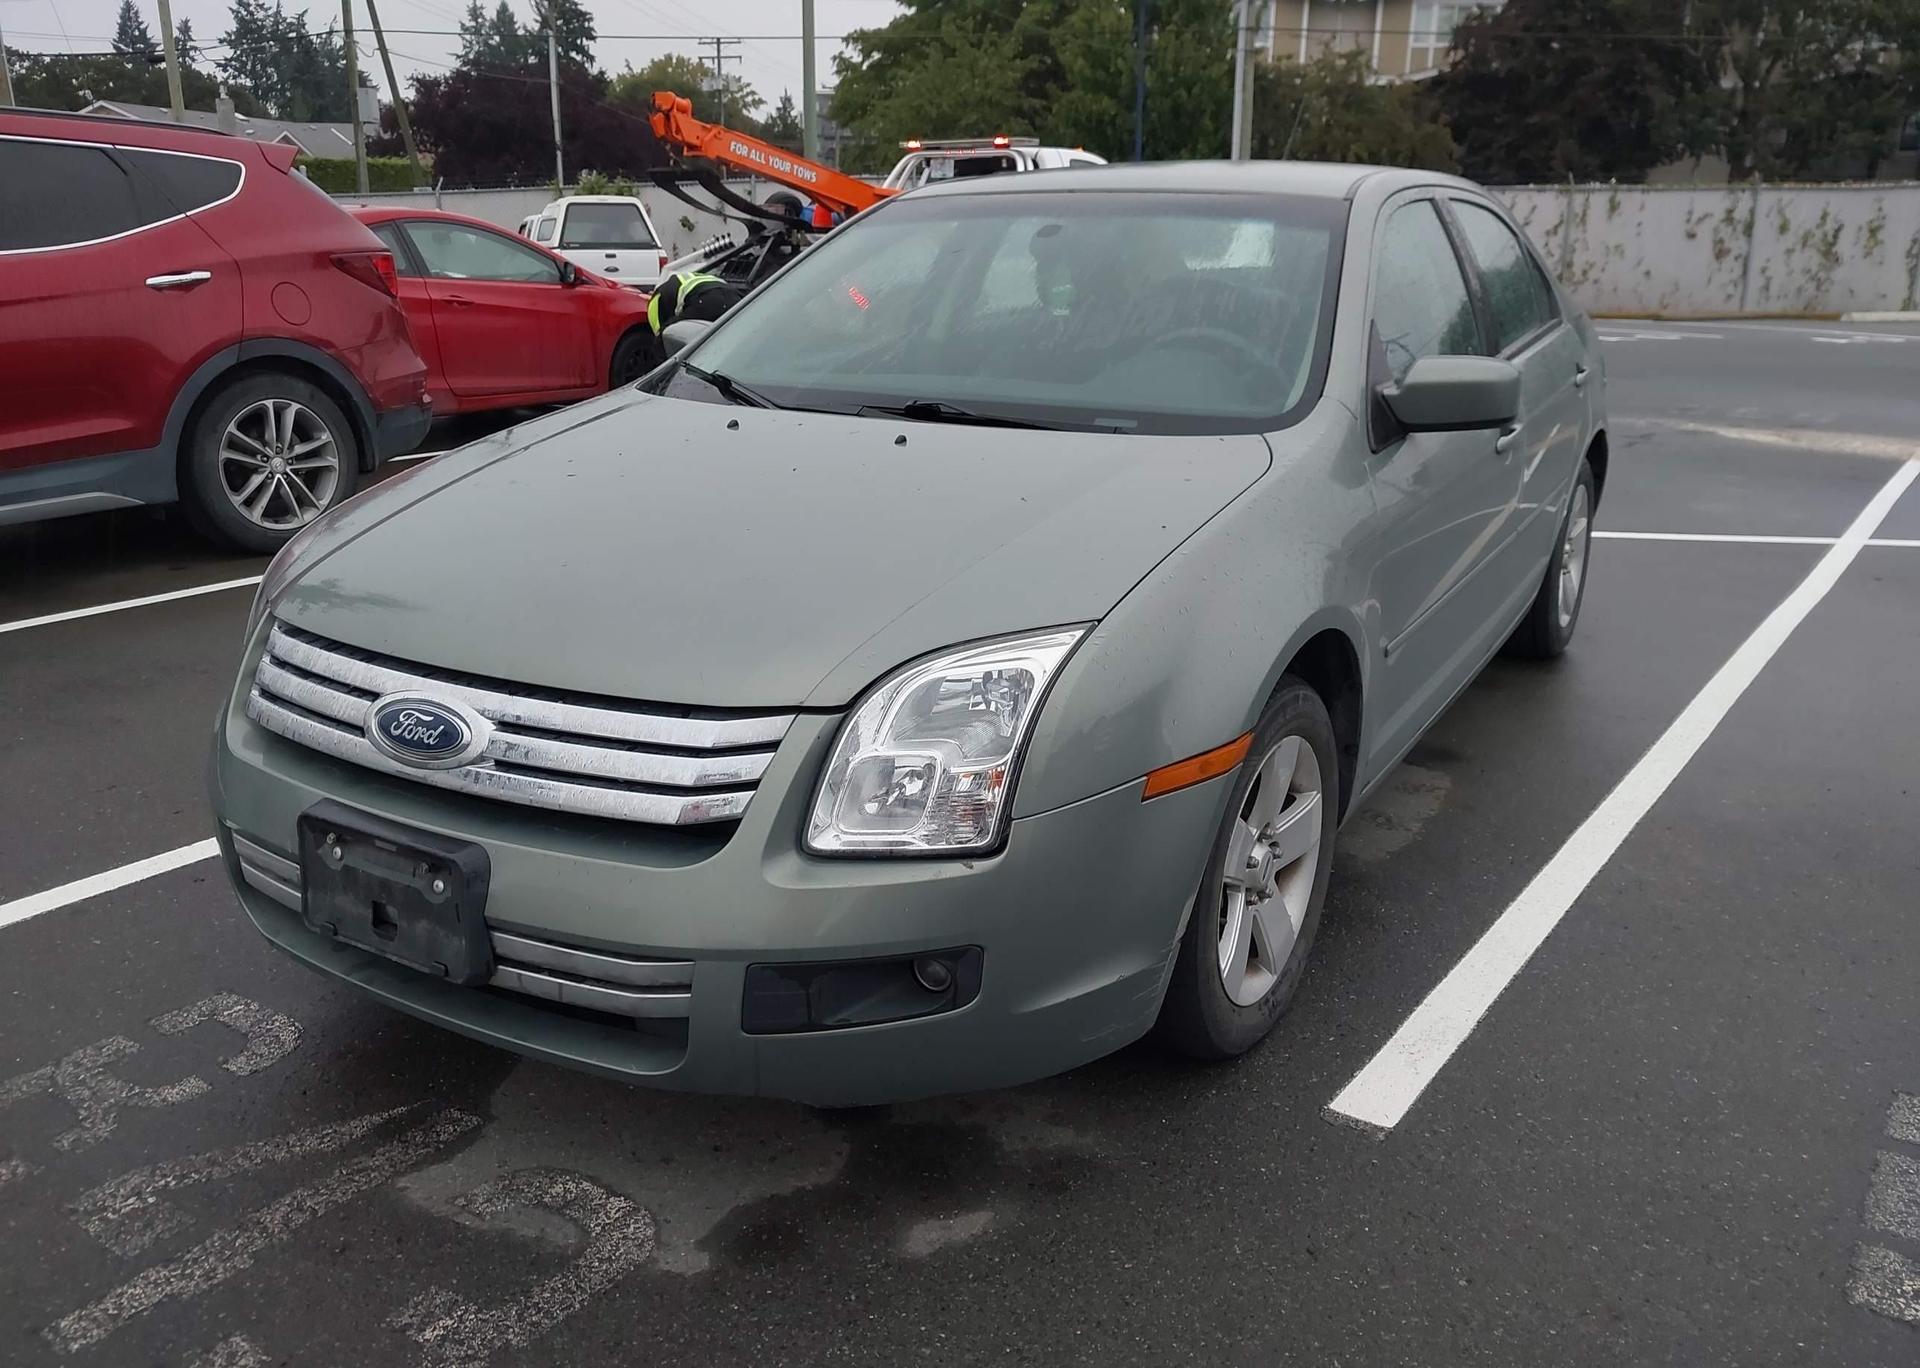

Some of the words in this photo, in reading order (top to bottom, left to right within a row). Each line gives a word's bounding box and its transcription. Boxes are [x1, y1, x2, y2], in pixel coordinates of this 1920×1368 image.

[730, 140, 749, 158] FOR
[750, 148, 767, 165] ALL
[768, 154, 792, 174] YOUR
[793, 164, 817, 184] TOWS
[390, 709, 445, 746] Ford
